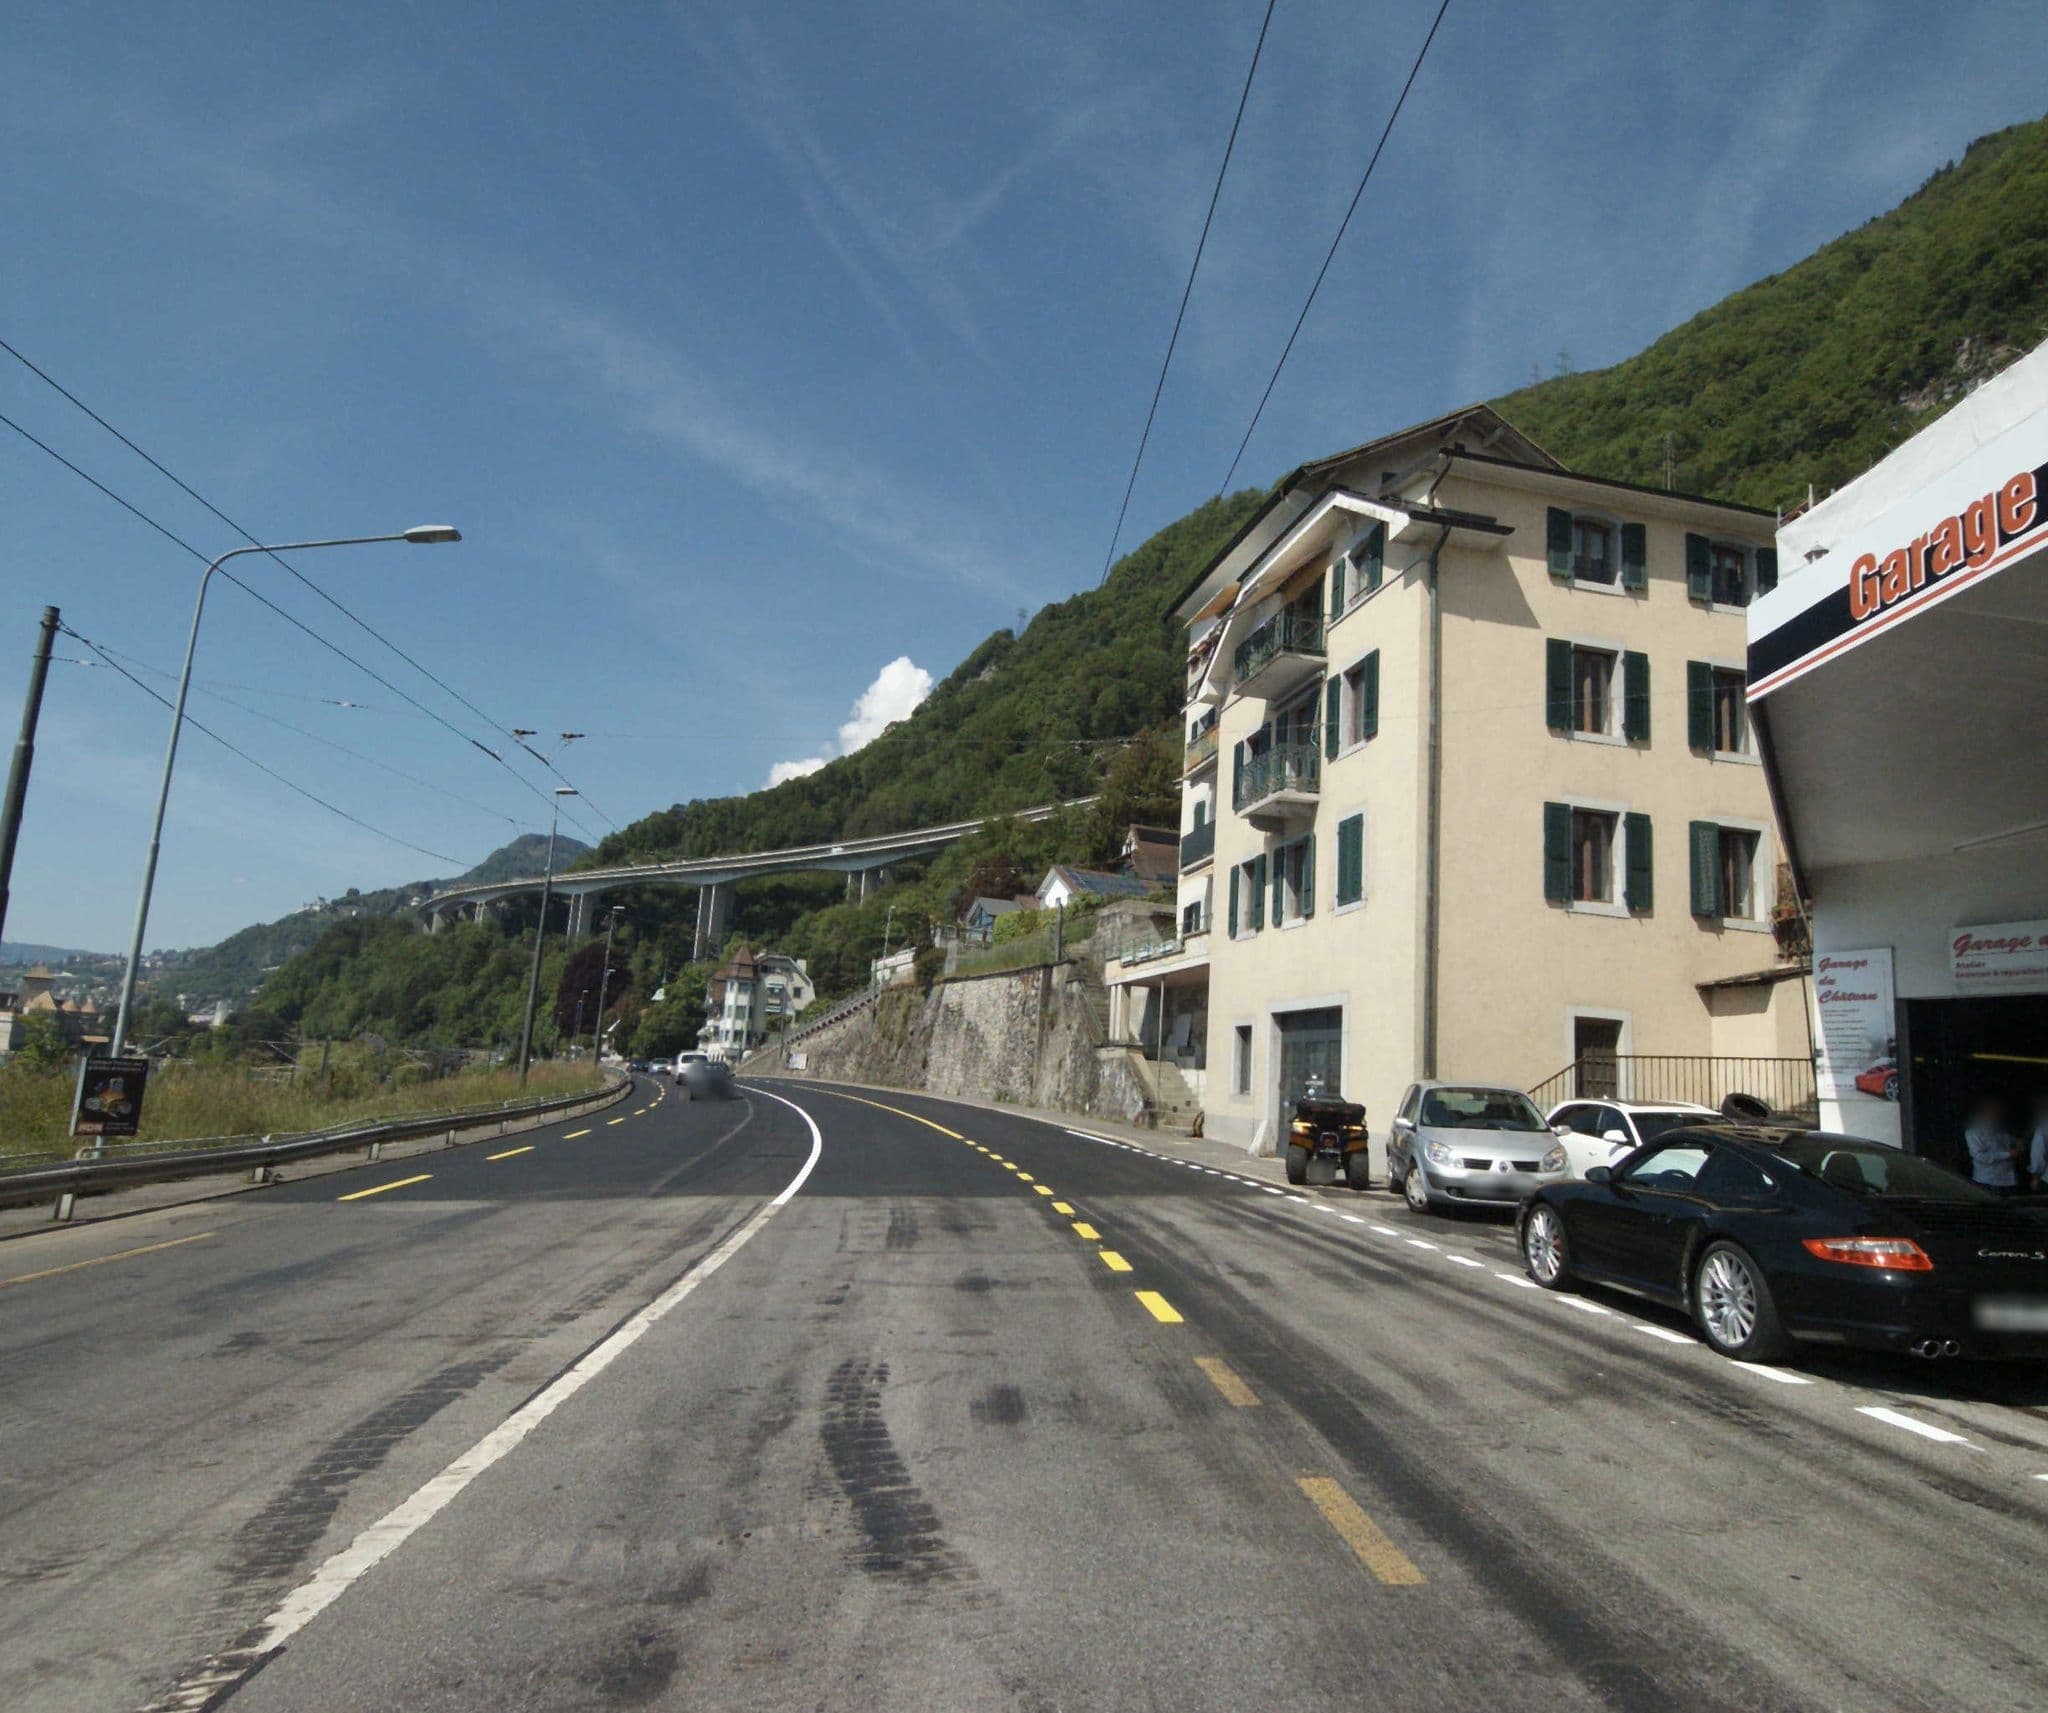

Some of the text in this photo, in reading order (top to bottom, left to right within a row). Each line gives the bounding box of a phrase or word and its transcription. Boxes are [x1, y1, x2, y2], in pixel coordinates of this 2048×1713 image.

[1849, 471, 2037, 621] Garage
[1953, 933, 2033, 958] Garage
[1819, 957, 1868, 973] Garage
